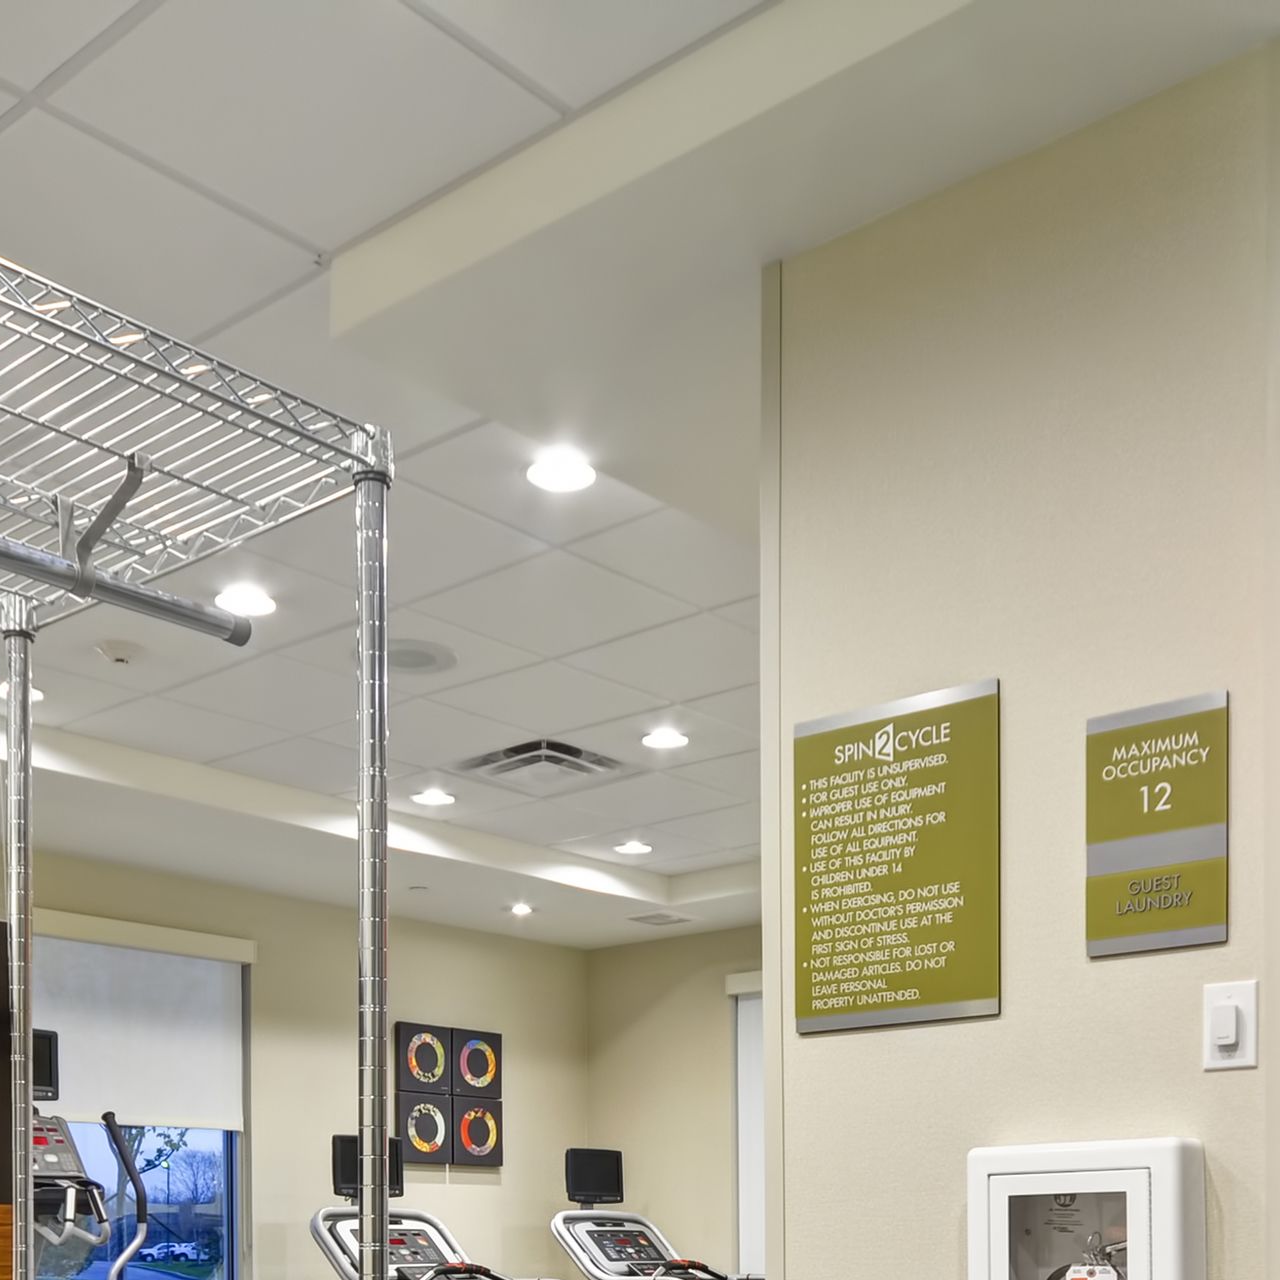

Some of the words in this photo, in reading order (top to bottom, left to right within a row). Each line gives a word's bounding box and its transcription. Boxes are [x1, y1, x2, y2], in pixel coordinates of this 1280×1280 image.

[834, 739, 873, 764] SPIN
[895, 722, 950, 751] CYCLE
[1112, 731, 1199, 762] MAXIMUM
[1102, 747, 1210, 781] OCCUPANCY
[810, 777, 828, 791] THIS
[830, 770, 865, 786] FACILITY
[867, 768, 876, 779] IS
[810, 791, 827, 804] FOR
[830, 785, 859, 800] GUEST
[861, 781, 879, 794] USE
[810, 800, 852, 817] IMPROPER
[855, 796, 872, 810] USE
[874, 793, 889, 805] OF
[891, 782, 946, 803] EQUIPMENT
[1140, 782, 1172, 813] 12
[811, 818, 832, 831] CAN
[834, 813, 864, 827] RESULT
[866, 810, 877, 821] IN
[811, 830, 849, 845] FOLLOW
[851, 826, 866, 838] ALL
[868, 815, 923, 835] DIRECTIONS
[925, 811, 946, 824] FOR
[810, 860, 827, 873] USE
[829, 857, 842, 869] OF
[845, 854, 863, 867] THIS
[866, 848, 901, 864] FACILITY
[904, 845, 916, 858] BY
[811, 846, 828, 859] USE
[830, 843, 843, 855] OF
[845, 841, 861, 853] ALL
[811, 870, 854, 886] CHILDREN
[856, 864, 888, 879] UNDER
[892, 863, 902, 874] 14
[1128, 873, 1182, 896] GUEST
[810, 901, 840, 913] WHEN
[899, 889, 915, 901] DO
[917, 885, 939, 898] NOT
[942, 881, 960, 894] USE
[811, 889, 819, 900] IS
[1116, 891, 1193, 916] LAUNDRY
[811, 912, 854, 927] WITHOUT
[906, 896, 964, 914] PERMISSION
[811, 930, 833, 941] AND
[835, 920, 898, 938] DISCONTINUE
[900, 917, 918, 929] USE
[920, 915, 932, 927] AT
[935, 912, 953, 924] THE
[810, 957, 831, 969] NOT
[833, 949, 890, 966] RESPONSIBLE
[892, 947, 912, 959] FOR
[914, 943, 937, 956] LOST
[940, 941, 955, 952] OR
[812, 943, 833, 955] FIRST
[835, 939, 858, 952] SIGN
[860, 937, 874, 949] OF
[812, 968, 859, 983] DAMAGED
[906, 959, 921, 971] DO
[924, 956, 946, 969] NOT
[812, 984, 838, 996] LEAVE
[840, 979, 887, 993] PERSONAL
[812, 996, 855, 1010] PROPERTY
